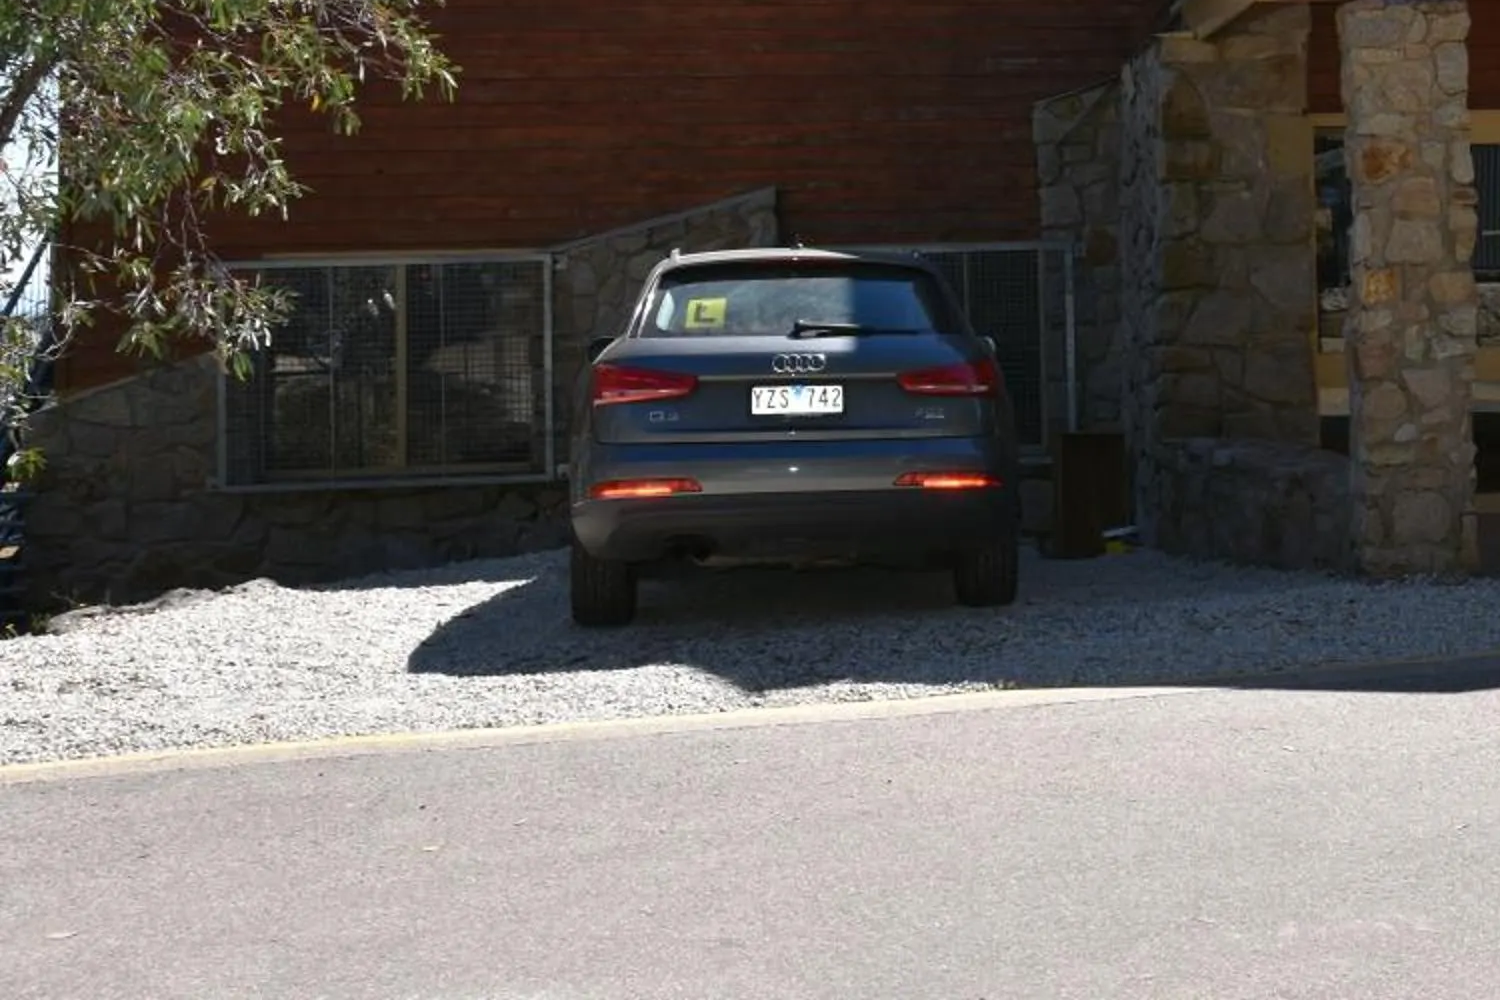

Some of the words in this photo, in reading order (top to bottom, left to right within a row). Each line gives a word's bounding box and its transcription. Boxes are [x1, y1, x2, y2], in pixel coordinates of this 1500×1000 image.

[694, 302, 716, 323] L
[752, 389, 789, 409] YZS
[807, 387, 841, 408] 742
